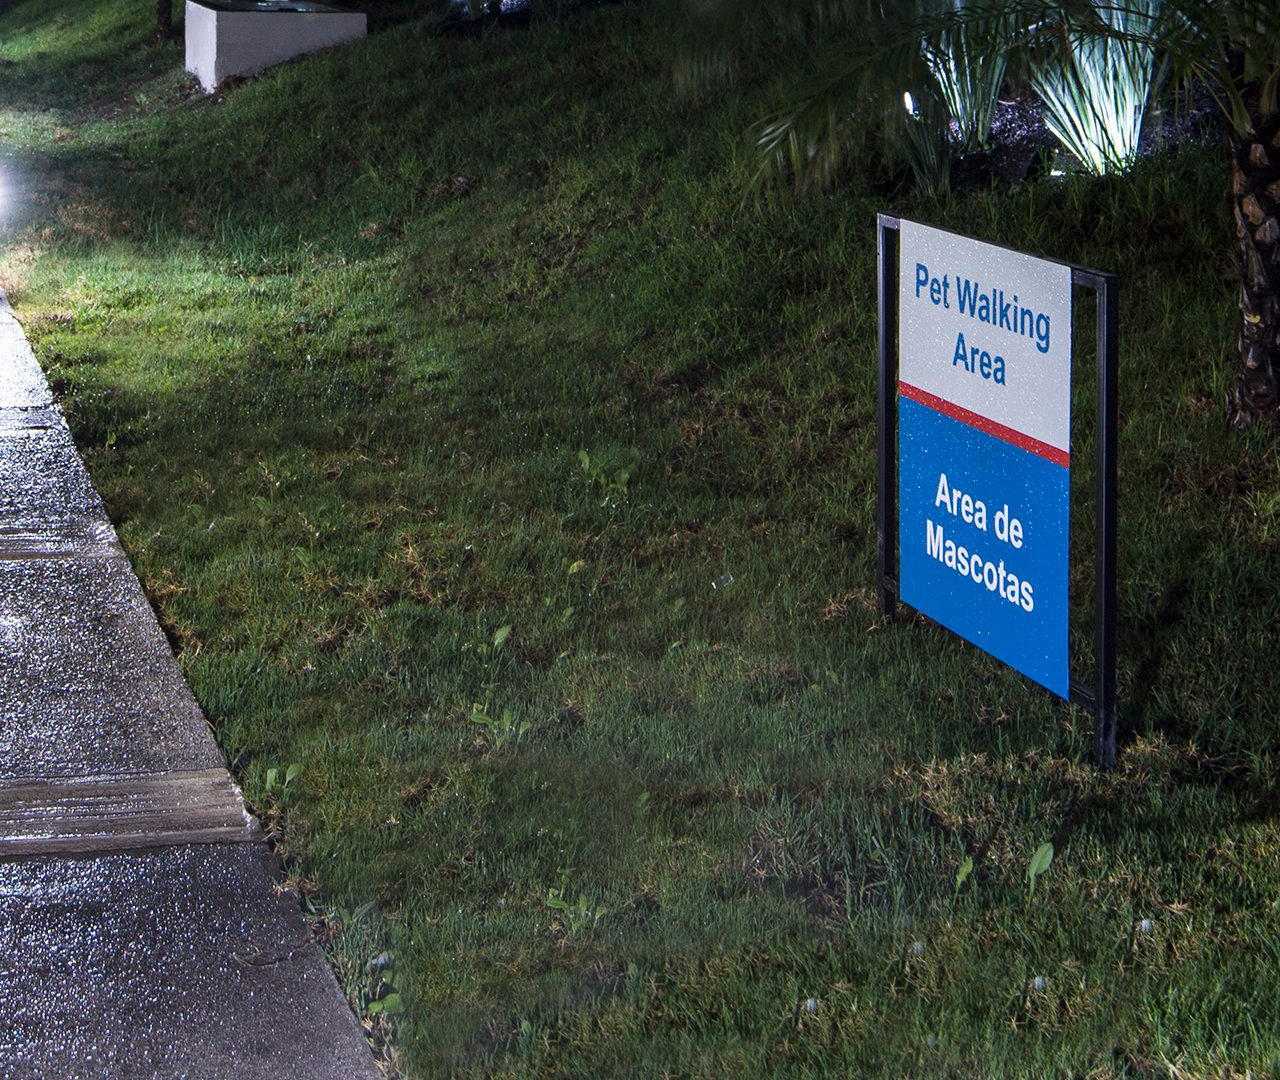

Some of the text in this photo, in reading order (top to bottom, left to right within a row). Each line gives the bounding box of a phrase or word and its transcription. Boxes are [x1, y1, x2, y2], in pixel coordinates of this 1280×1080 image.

[915, 262, 1051, 354] Pet Walking
[952, 331, 1006, 386] Area
[934, 472, 1024, 550] Area de
[925, 518, 1035, 613] Mascotas
